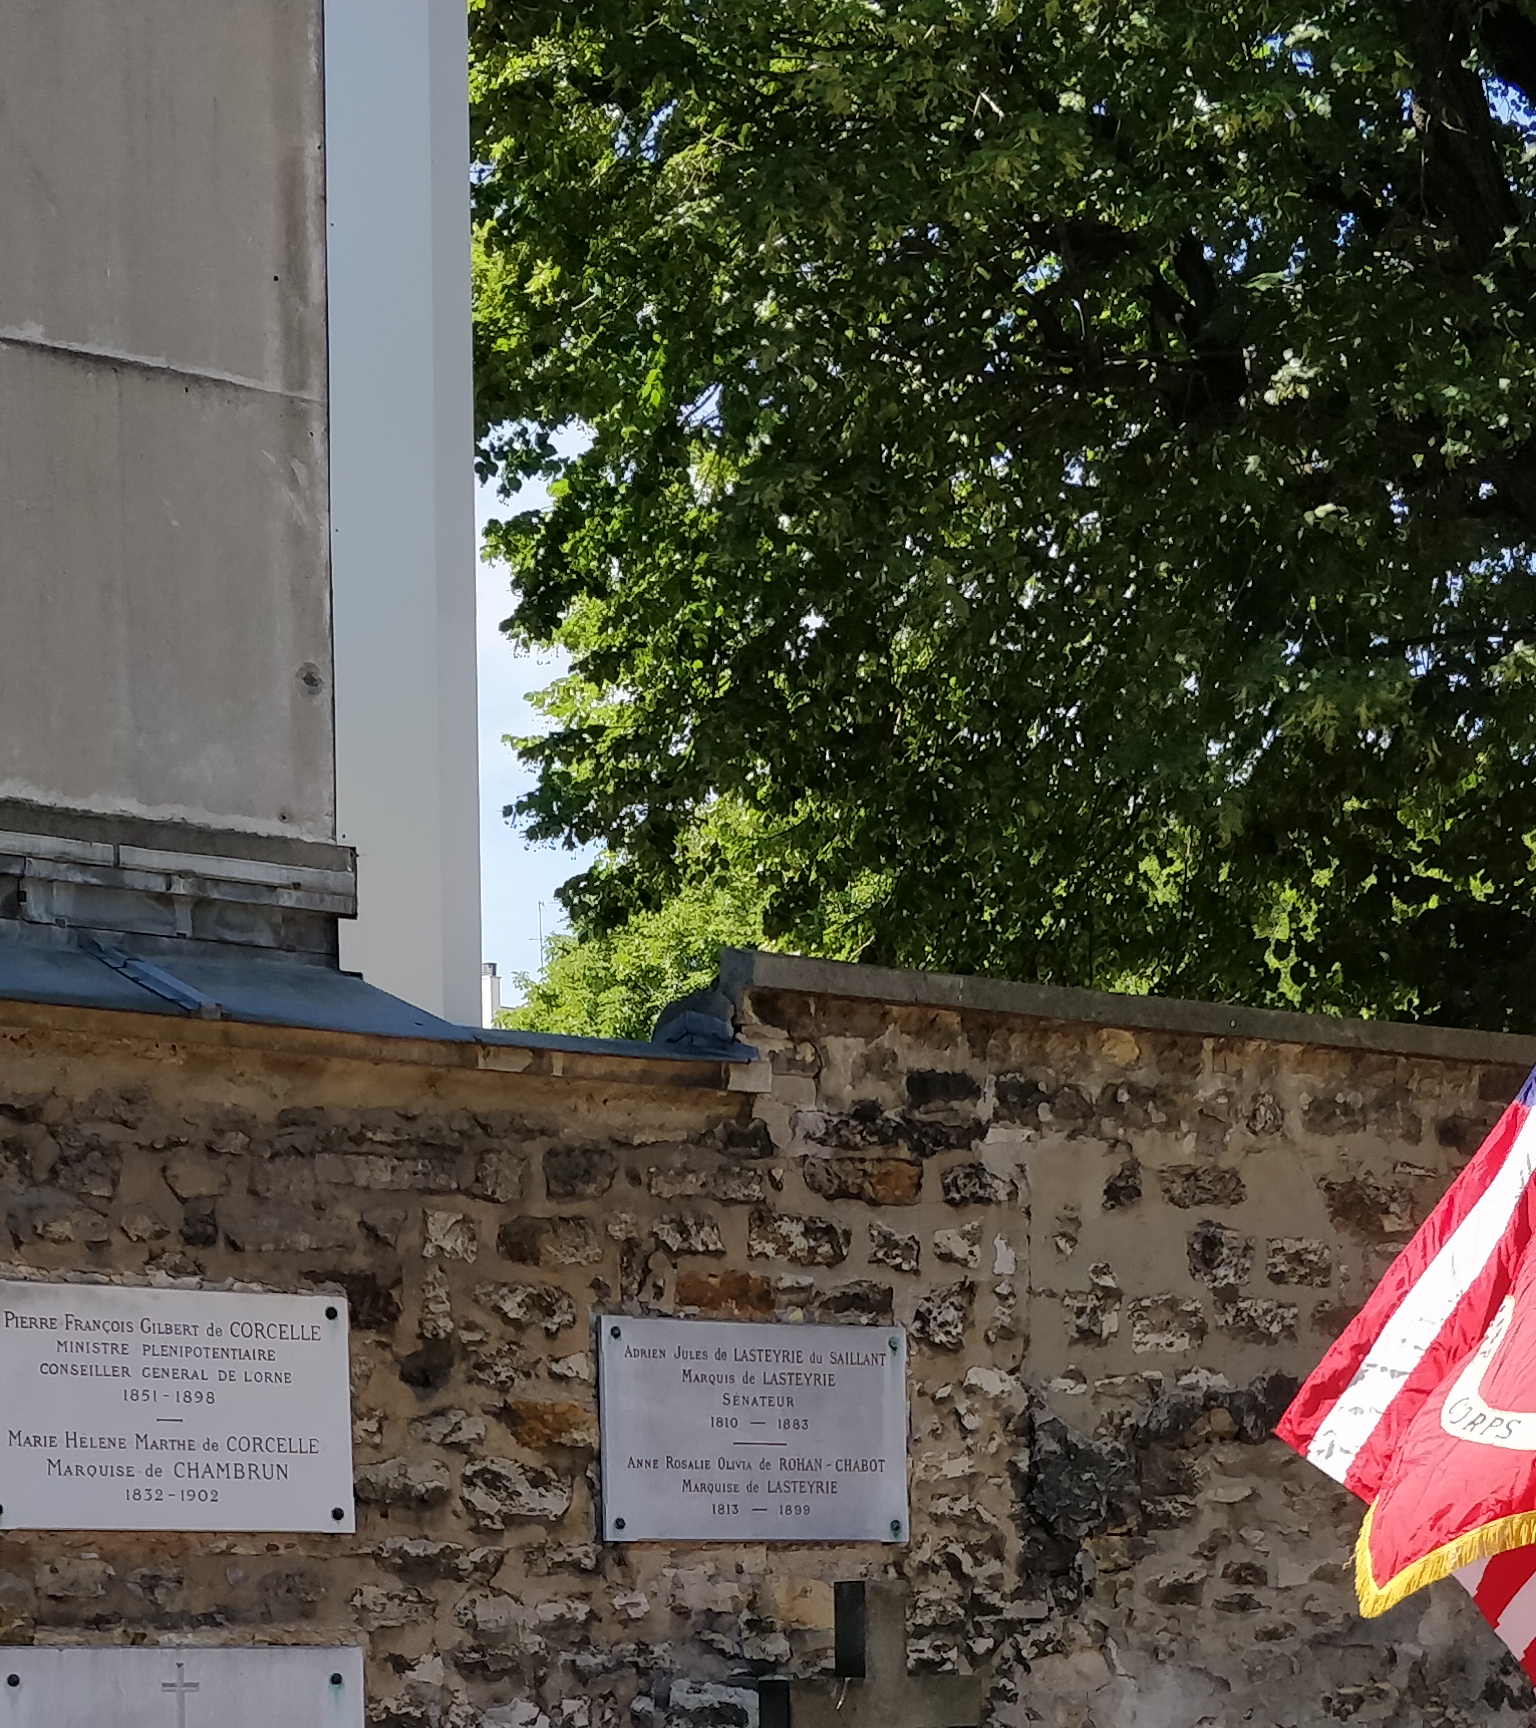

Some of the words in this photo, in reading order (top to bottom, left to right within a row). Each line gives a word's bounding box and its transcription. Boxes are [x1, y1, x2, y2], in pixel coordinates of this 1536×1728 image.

[4, 1311, 58, 1330] PIERRE
[64, 1314, 134, 1335] FRANÇOIS
[140, 1318, 199, 1337] GILBERT
[206, 1321, 223, 1338] de
[230, 1322, 322, 1341] CORCELLE
[56, 1340, 130, 1356] MINISTRE
[624, 1345, 666, 1359] ADRIEN
[673, 1345, 708, 1360] JULES
[714, 1347, 728, 1361] de
[733, 1348, 804, 1364] LASTEYRIE
[809, 1351, 823, 1364] du
[829, 1351, 887, 1367] SAILLANT
[39, 1363, 132, 1379] CONSEILLER
[218, 1369, 237, 1382] DE
[244, 1370, 293, 1384] LORNE
[681, 1369, 735, 1384] MARQUIS
[742, 1371, 756, 1385] de
[762, 1372, 836, 1387] LASTEYRIE
[710, 1416, 739, 1429] 1810
[777, 1418, 809, 1430] 1883
[8, 1431, 58, 1448] MARIE
[135, 1433, 196, 1451] MARTHE
[202, 1436, 220, 1452] de
[226, 1436, 320, 1455] CORCELLE
[47, 1458, 135, 1479] MARQUISE
[145, 1462, 163, 1479] de
[173, 1462, 289, 1481] CHAMBRUN
[627, 1456, 659, 1469] ANNE
[666, 1456, 711, 1470] ROSALIE
[717, 1457, 753, 1471] OLIVIA
[759, 1457, 771, 1471] de
[681, 1479, 740, 1494] MARQUISE
[746, 1481, 759, 1493] de
[767, 1481, 838, 1494] LASTEYRIE
[712, 1503, 739, 1515] 1813
